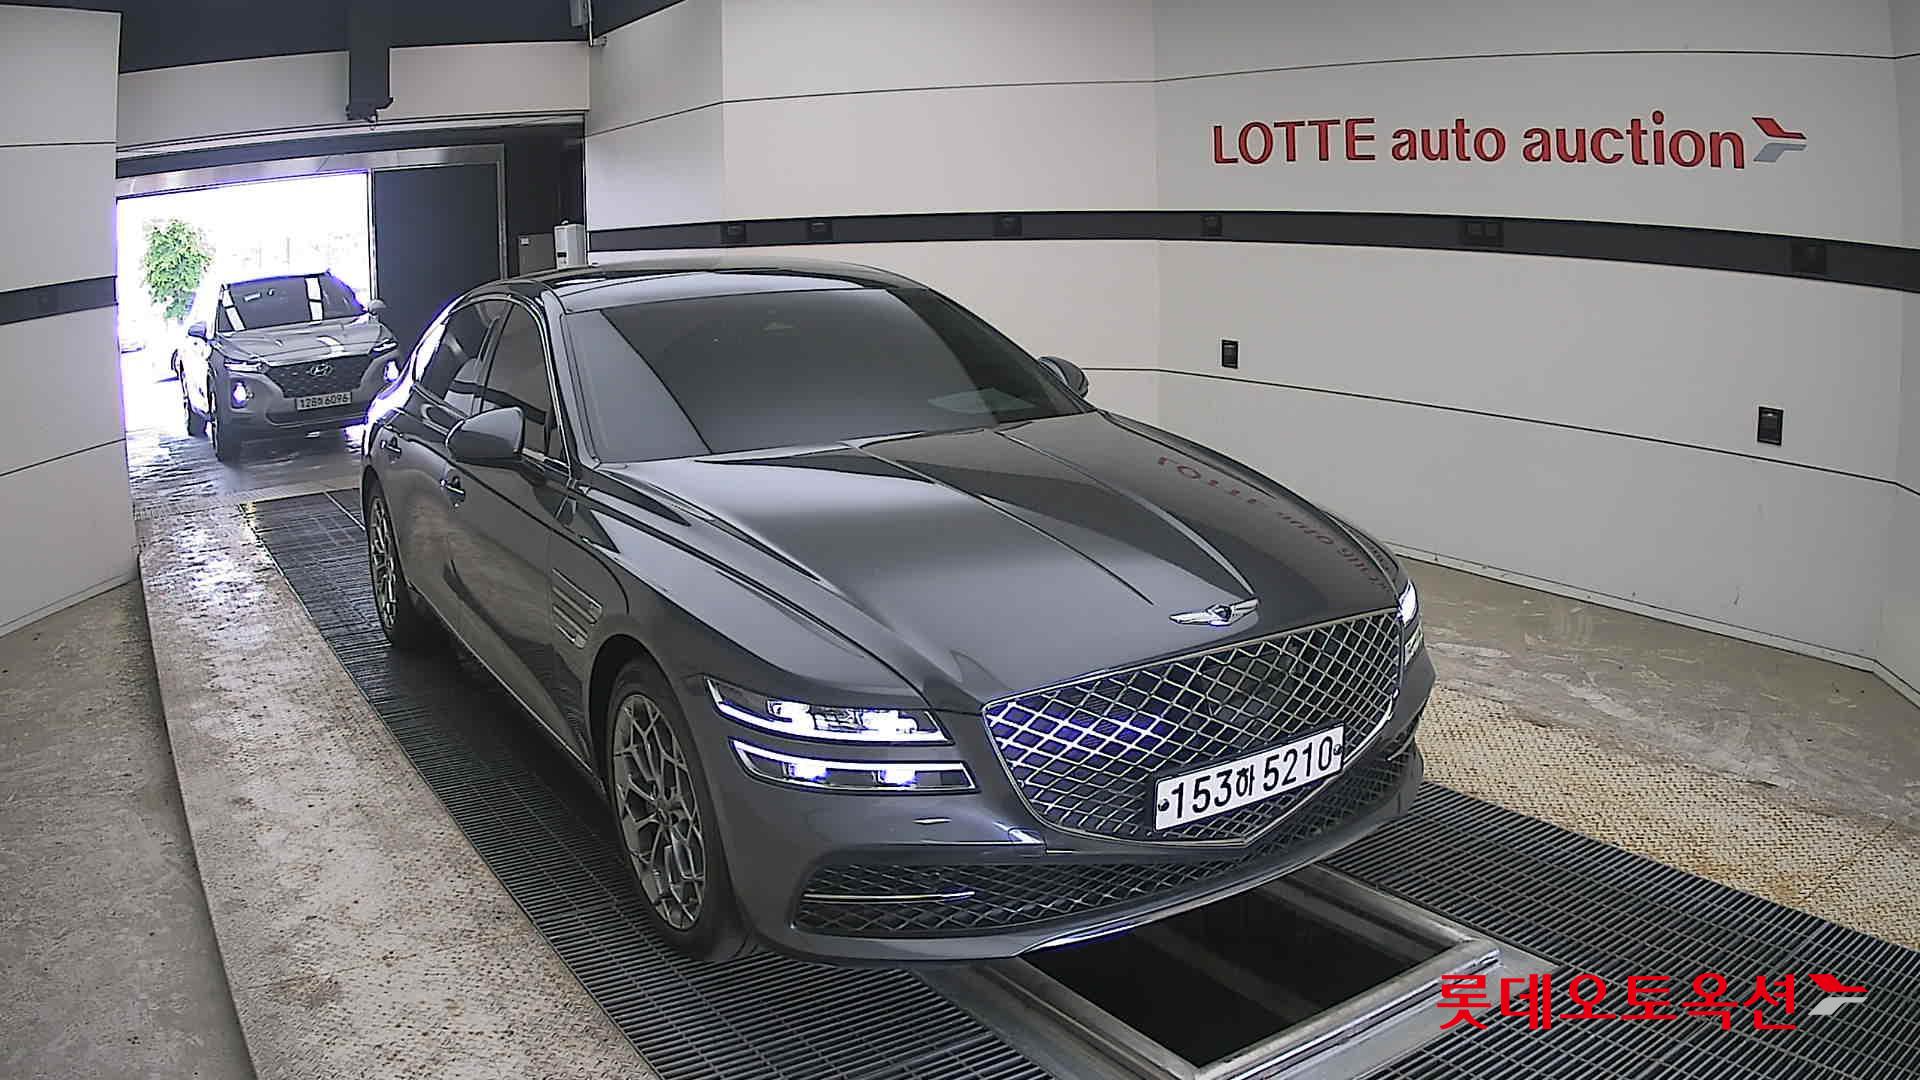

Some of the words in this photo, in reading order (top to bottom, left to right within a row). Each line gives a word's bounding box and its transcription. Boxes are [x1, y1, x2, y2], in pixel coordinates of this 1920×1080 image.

[1213, 117, 1376, 165] LOTTE
[1391, 117, 1507, 162] auto
[1521, 110, 1745, 170] auction
[1171, 763, 1256, 819] 153하
[1263, 735, 1334, 792] 5210
